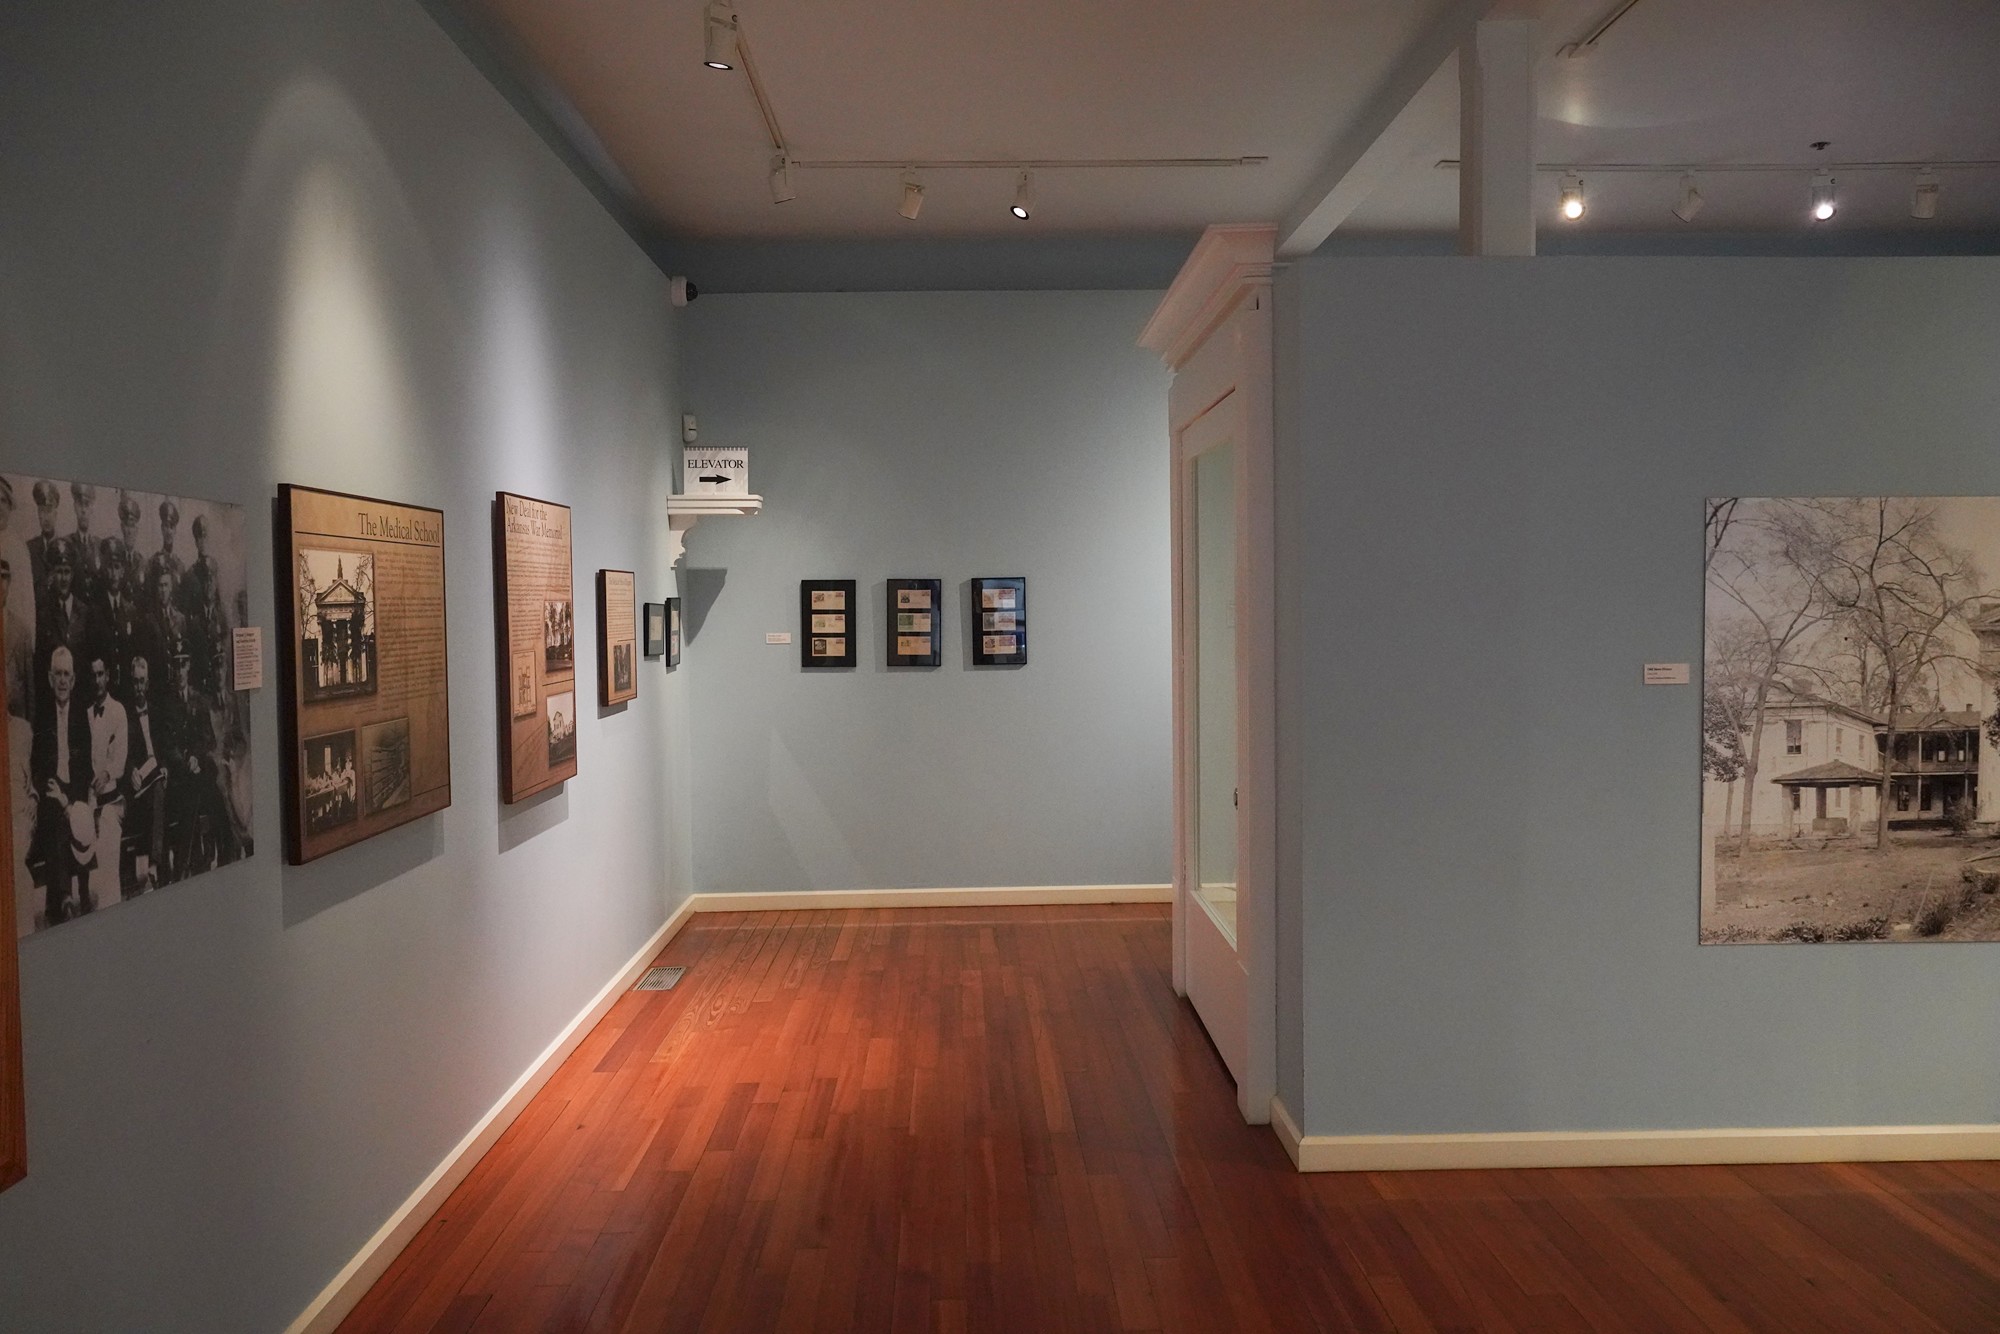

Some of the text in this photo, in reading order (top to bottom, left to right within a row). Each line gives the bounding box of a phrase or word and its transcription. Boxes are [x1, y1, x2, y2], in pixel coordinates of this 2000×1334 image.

[687, 459, 744, 469] ELEVATOR
[520, 500, 531, 518] Deal
[358, 512, 440, 543] The Medical School
